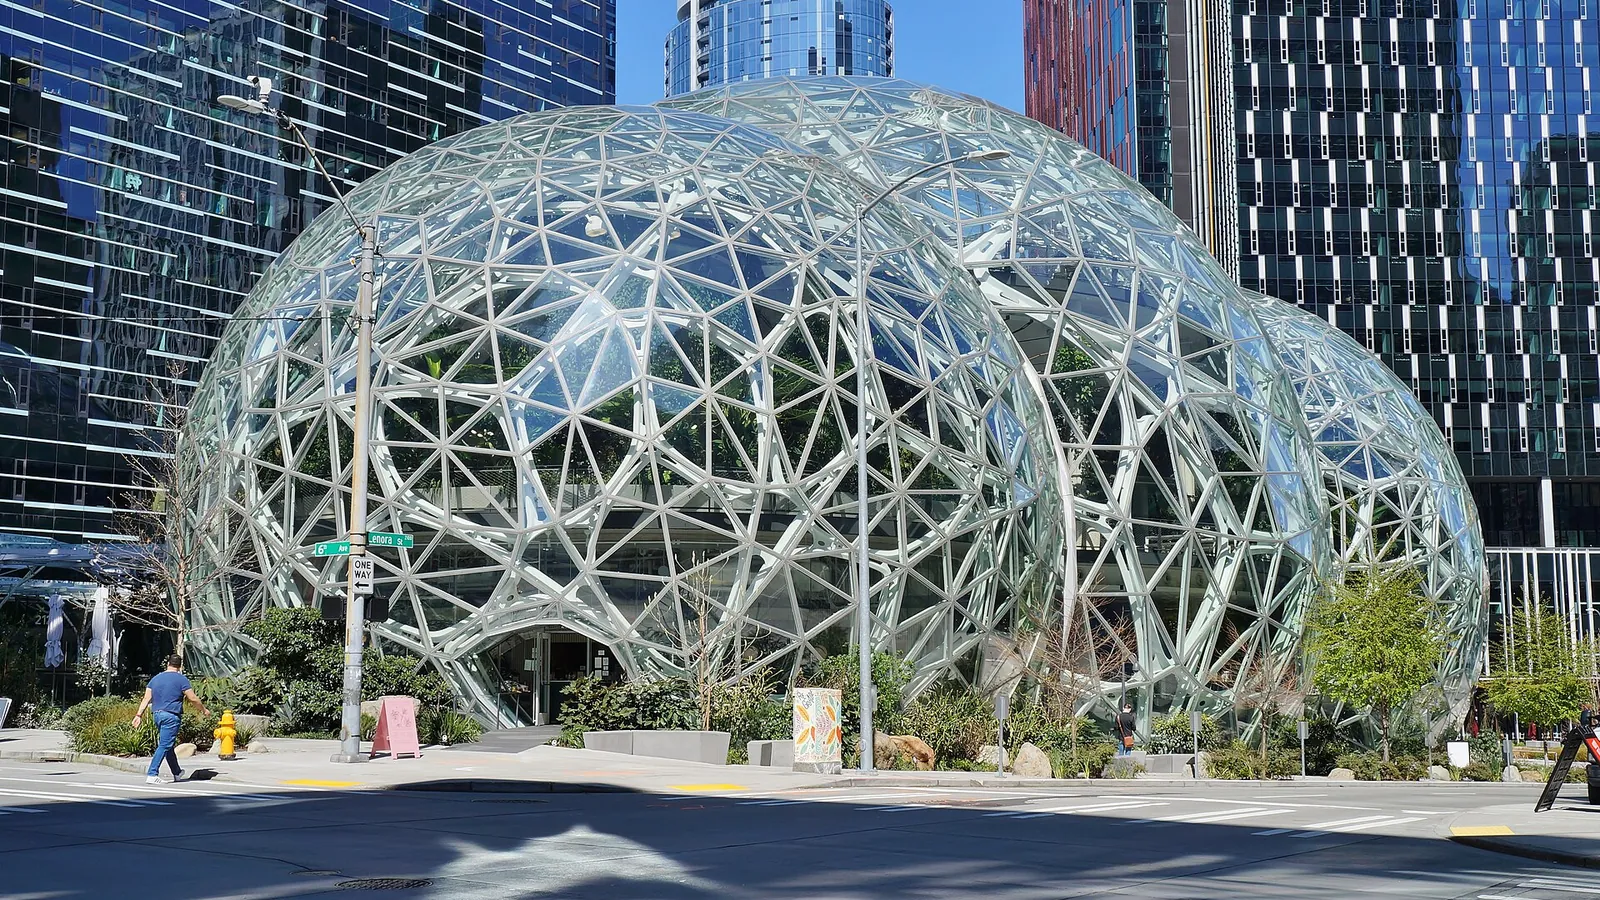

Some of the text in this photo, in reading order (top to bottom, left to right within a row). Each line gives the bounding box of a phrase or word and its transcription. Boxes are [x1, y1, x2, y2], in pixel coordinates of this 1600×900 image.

[397, 538, 403, 546] St
[355, 560, 371, 569] ONE
[354, 571, 371, 579] WAY
